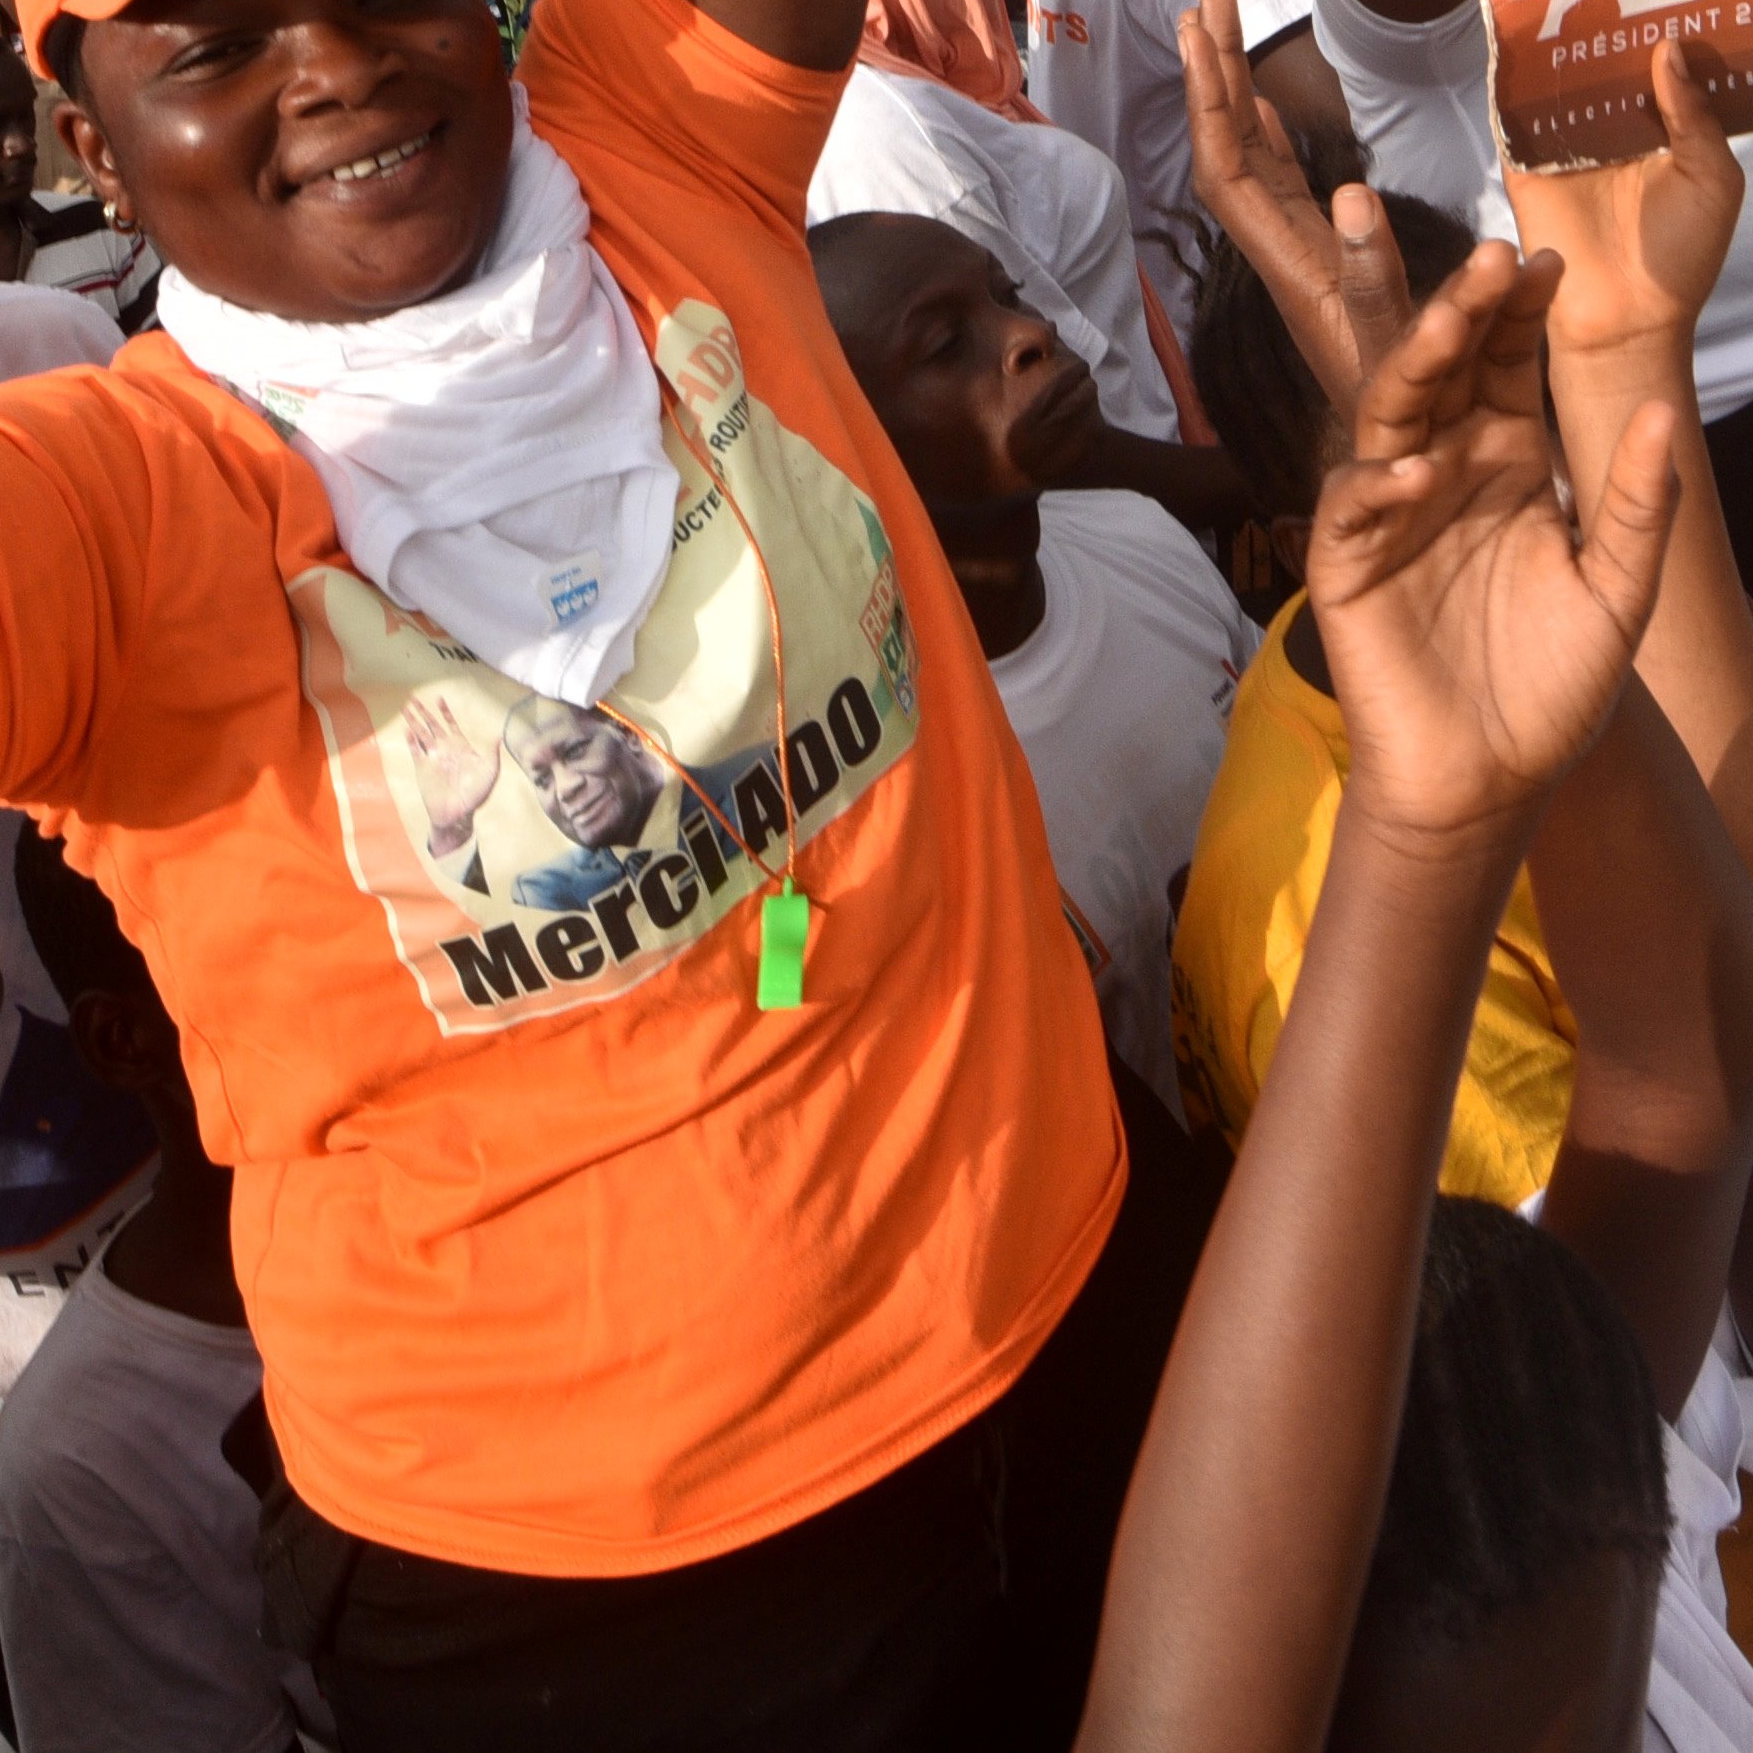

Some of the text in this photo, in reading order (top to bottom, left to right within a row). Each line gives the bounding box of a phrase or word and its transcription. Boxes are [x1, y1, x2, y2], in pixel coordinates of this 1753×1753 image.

[1551, 7, 1722, 70] PRÉSIDENT
[1533, 93, 1645, 136] ÉLECTIO
[439, 676, 884, 1008] Merci ADO
